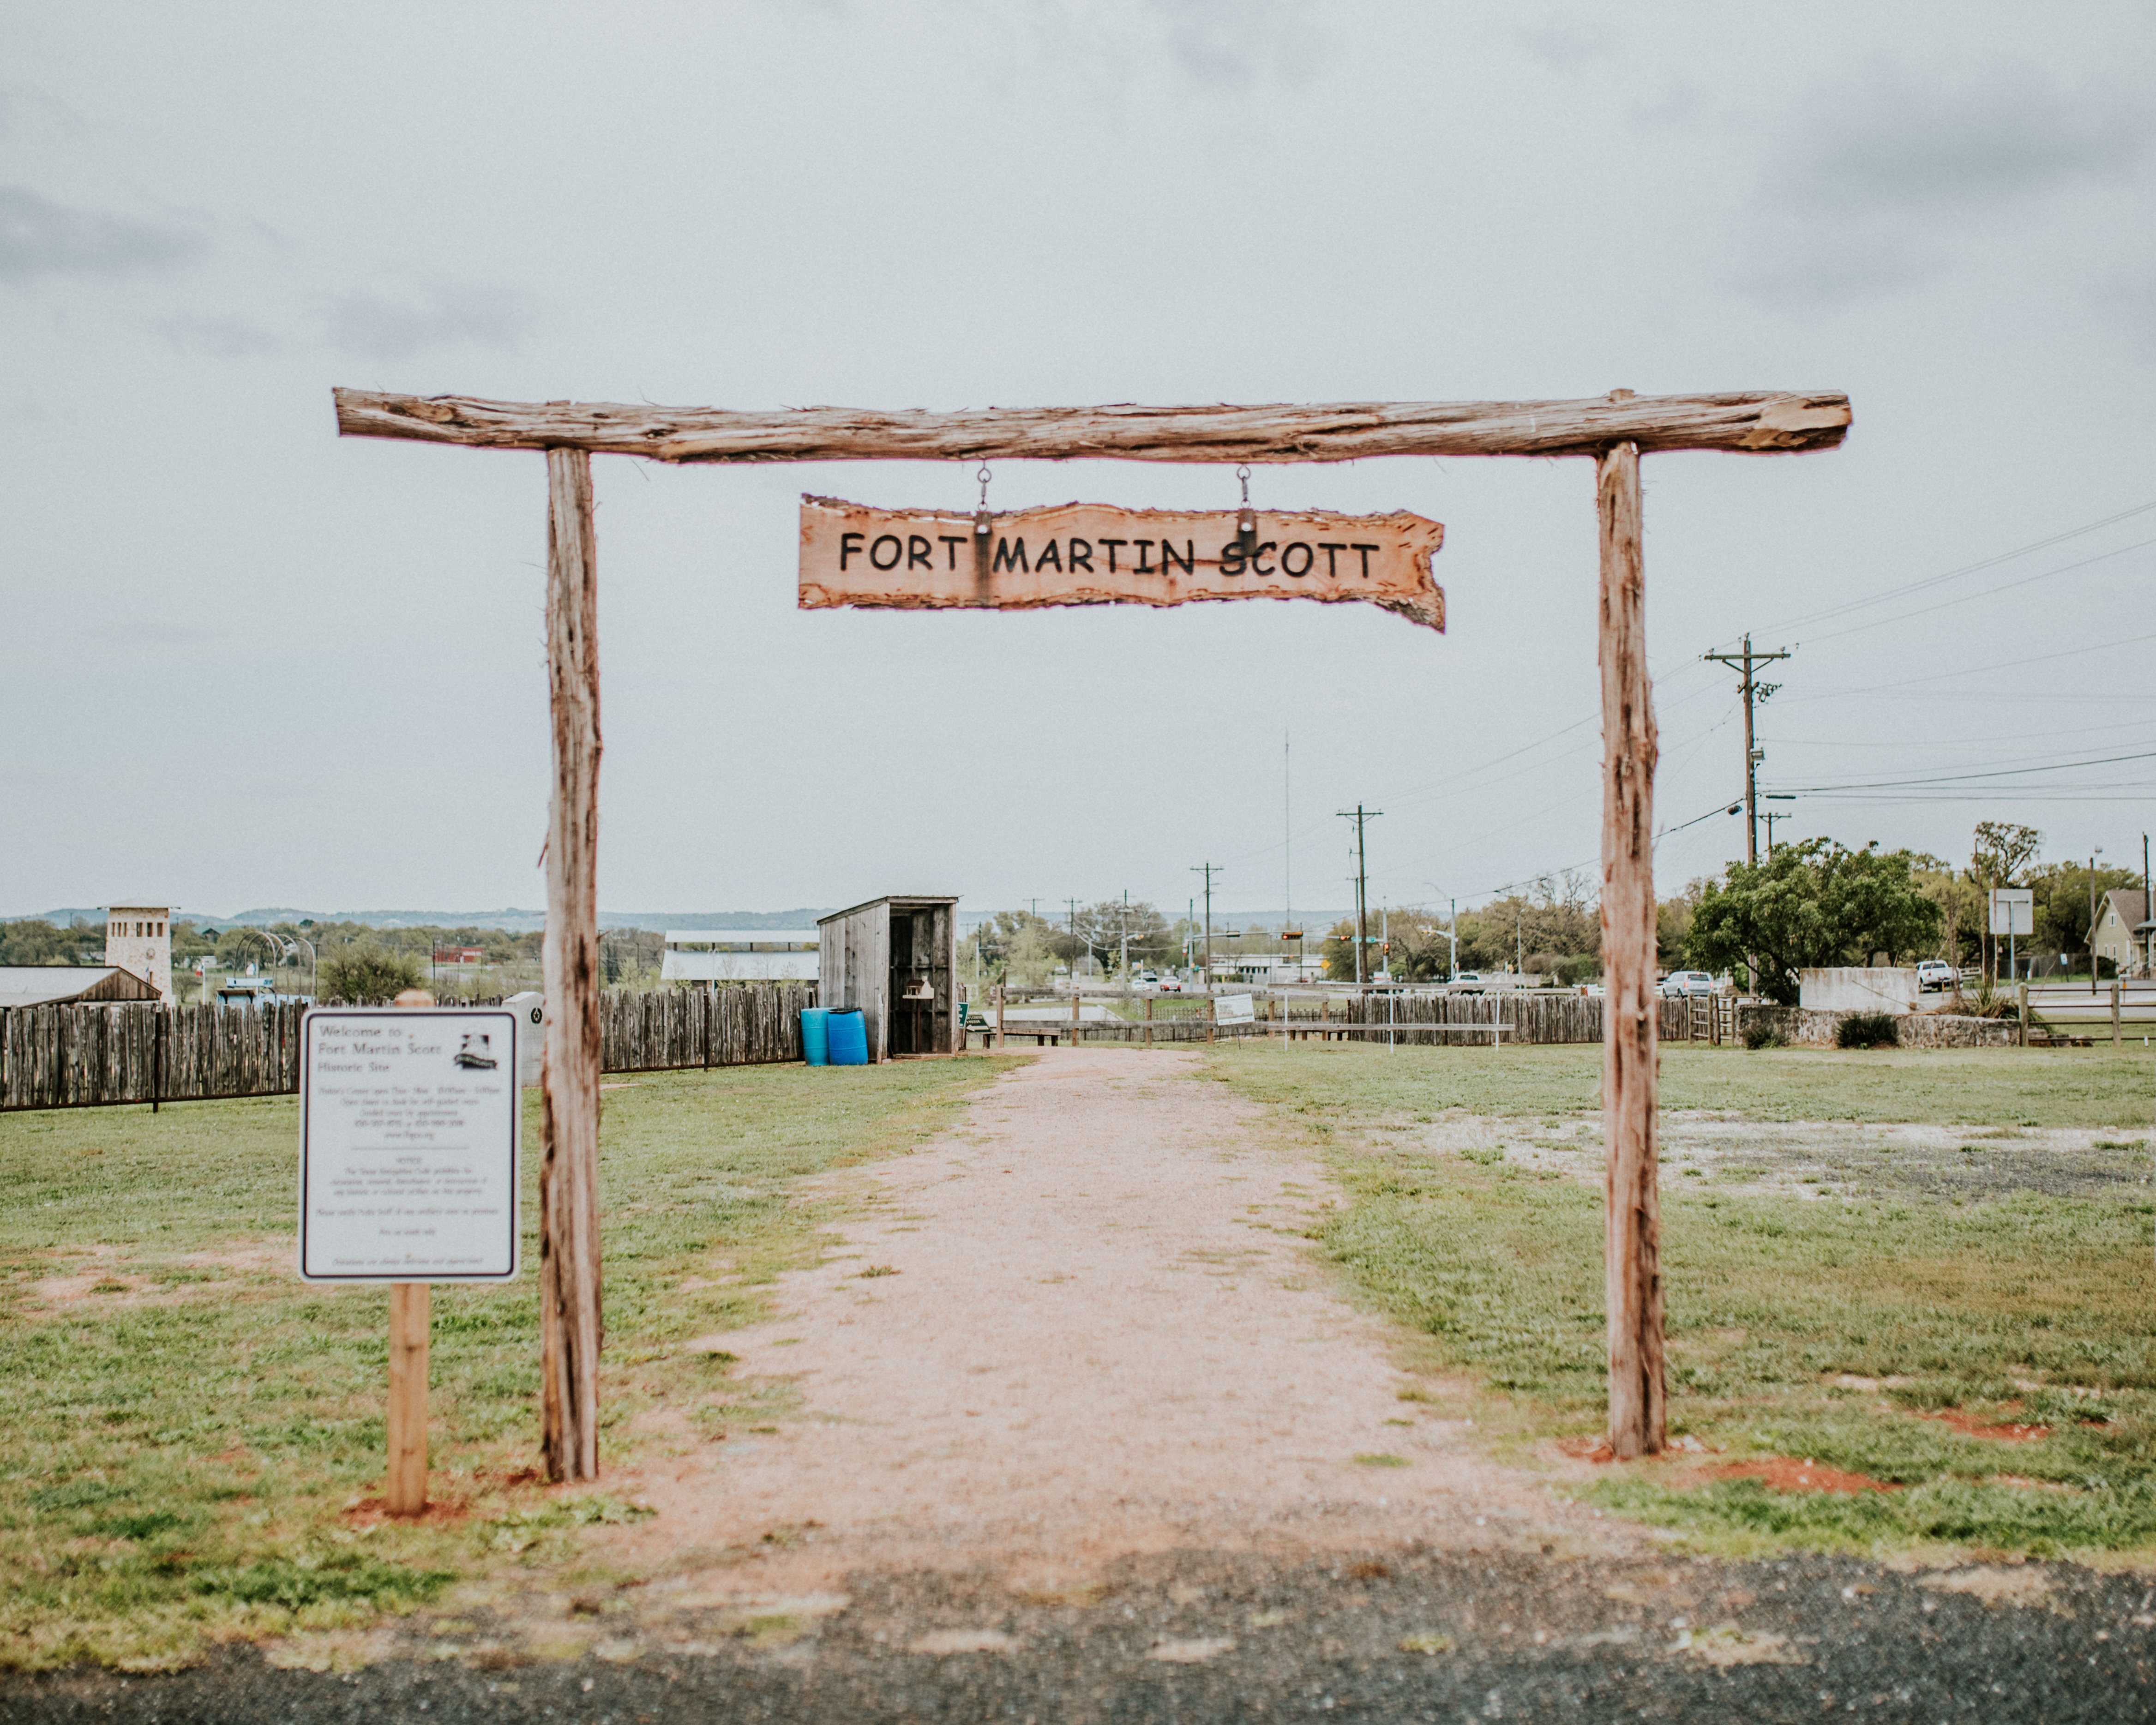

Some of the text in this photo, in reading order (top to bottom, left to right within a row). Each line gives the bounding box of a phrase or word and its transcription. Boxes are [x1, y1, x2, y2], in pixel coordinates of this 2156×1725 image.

[840, 532, 1380, 578] FORT MARTIN SCOTT
[319, 1025, 402, 1037] Welcome to
[318, 1042, 442, 1055] Fort Martin Scott
[318, 1061, 390, 1072] Historic Site
